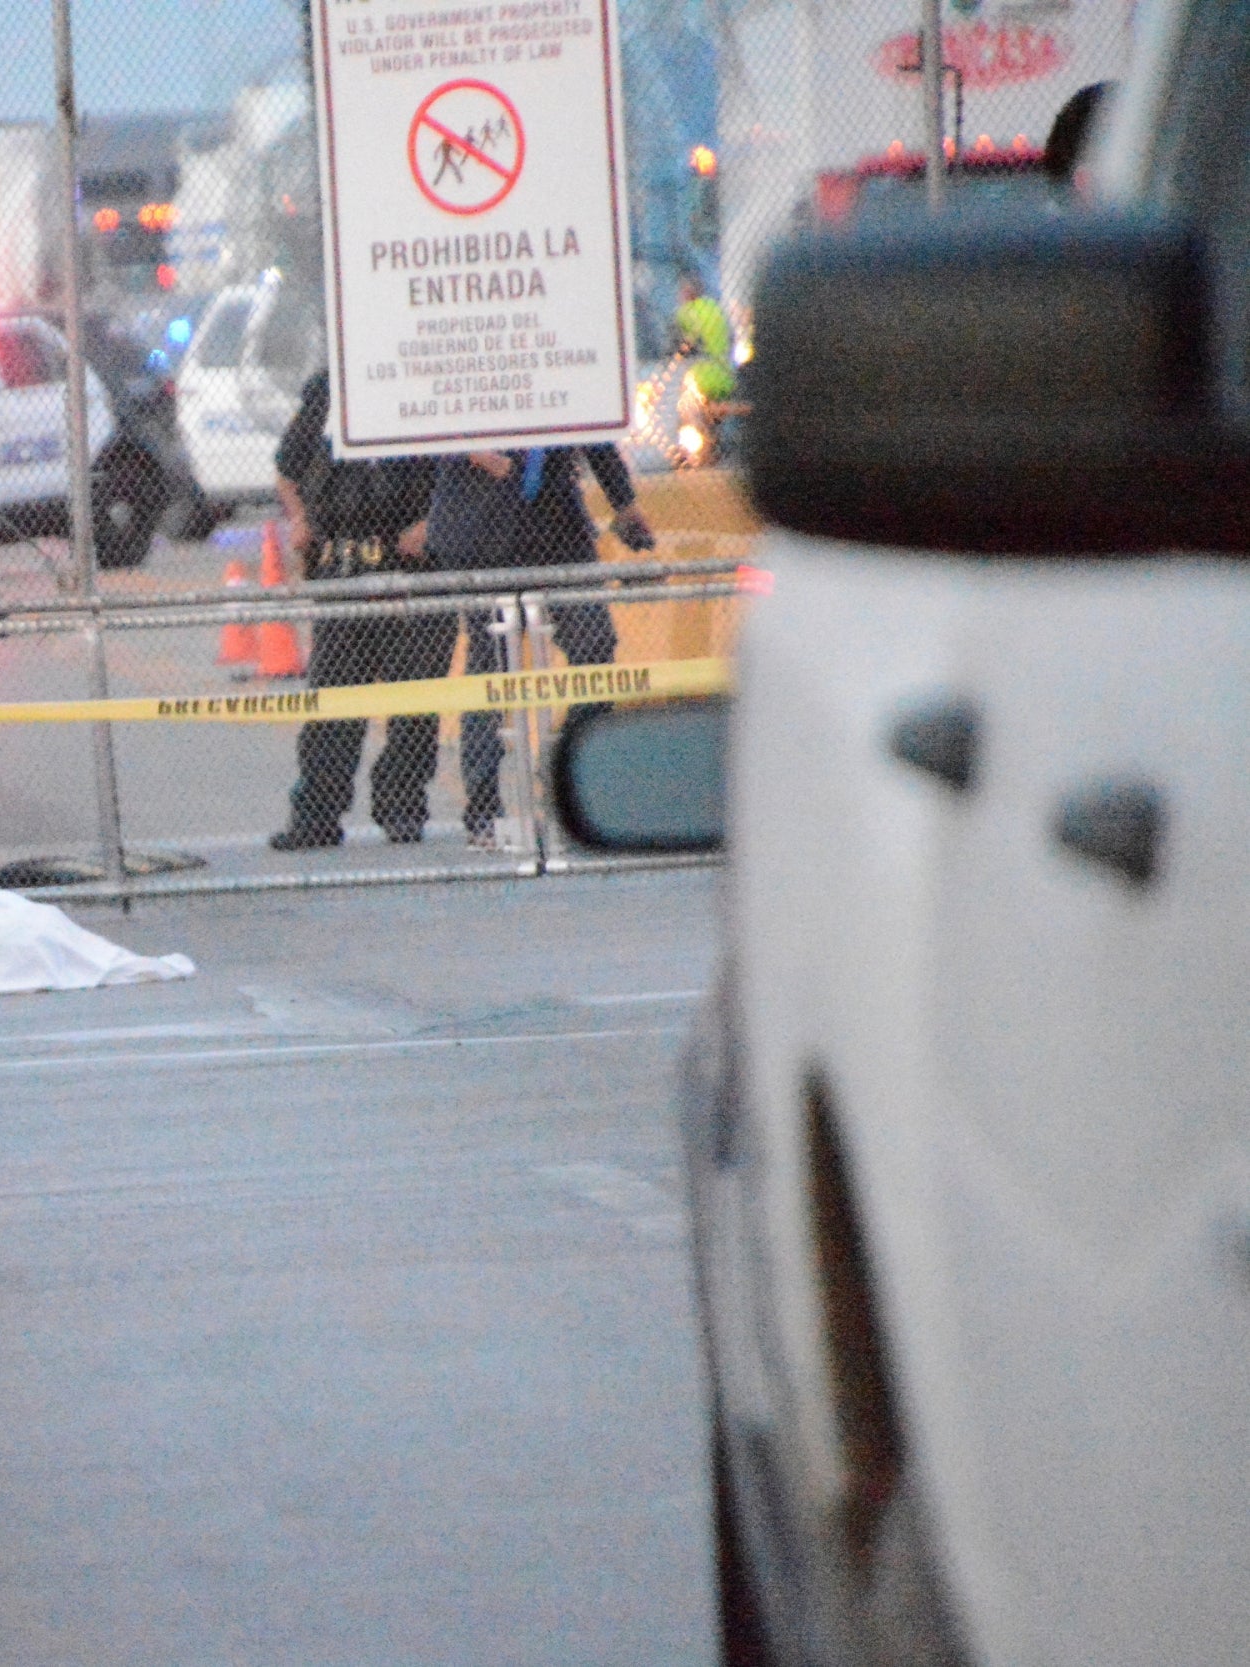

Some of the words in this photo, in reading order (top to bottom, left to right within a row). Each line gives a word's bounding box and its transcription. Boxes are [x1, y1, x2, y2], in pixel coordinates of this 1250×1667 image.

[385, 6, 493, 31] GOVERNMENT
[499, 0, 581, 21] PROPERTY
[338, 34, 415, 56] VIOLATOR
[420, 31, 458, 48] WILL
[464, 28, 482, 45] BE
[489, 17, 593, 42] PROSECUTED
[370, 53, 424, 74] UNDER
[429, 48, 496, 67] PENALTY
[503, 44, 522, 62] OF
[529, 41, 563, 59] LAW
[371, 229, 534, 272] PROHIBIDA
[544, 226, 580, 257] LA
[408, 267, 548, 307] ENTRADA
[416, 314, 507, 336] PROPIEDAD
[511, 312, 541, 330] DEL
[398, 335, 479, 358] GOBIERNO
[484, 334, 503, 352] DE
[366, 361, 398, 381] LOS
[403, 352, 538, 377] TRANSGRESORES
[432, 373, 533, 395] CASTIGADOS
[399, 399, 439, 418] BAJO
[444, 397, 463, 416] LA
[468, 394, 509, 413] PENA
[514, 392, 535, 410] DE
[540, 390, 569, 408] LEY
